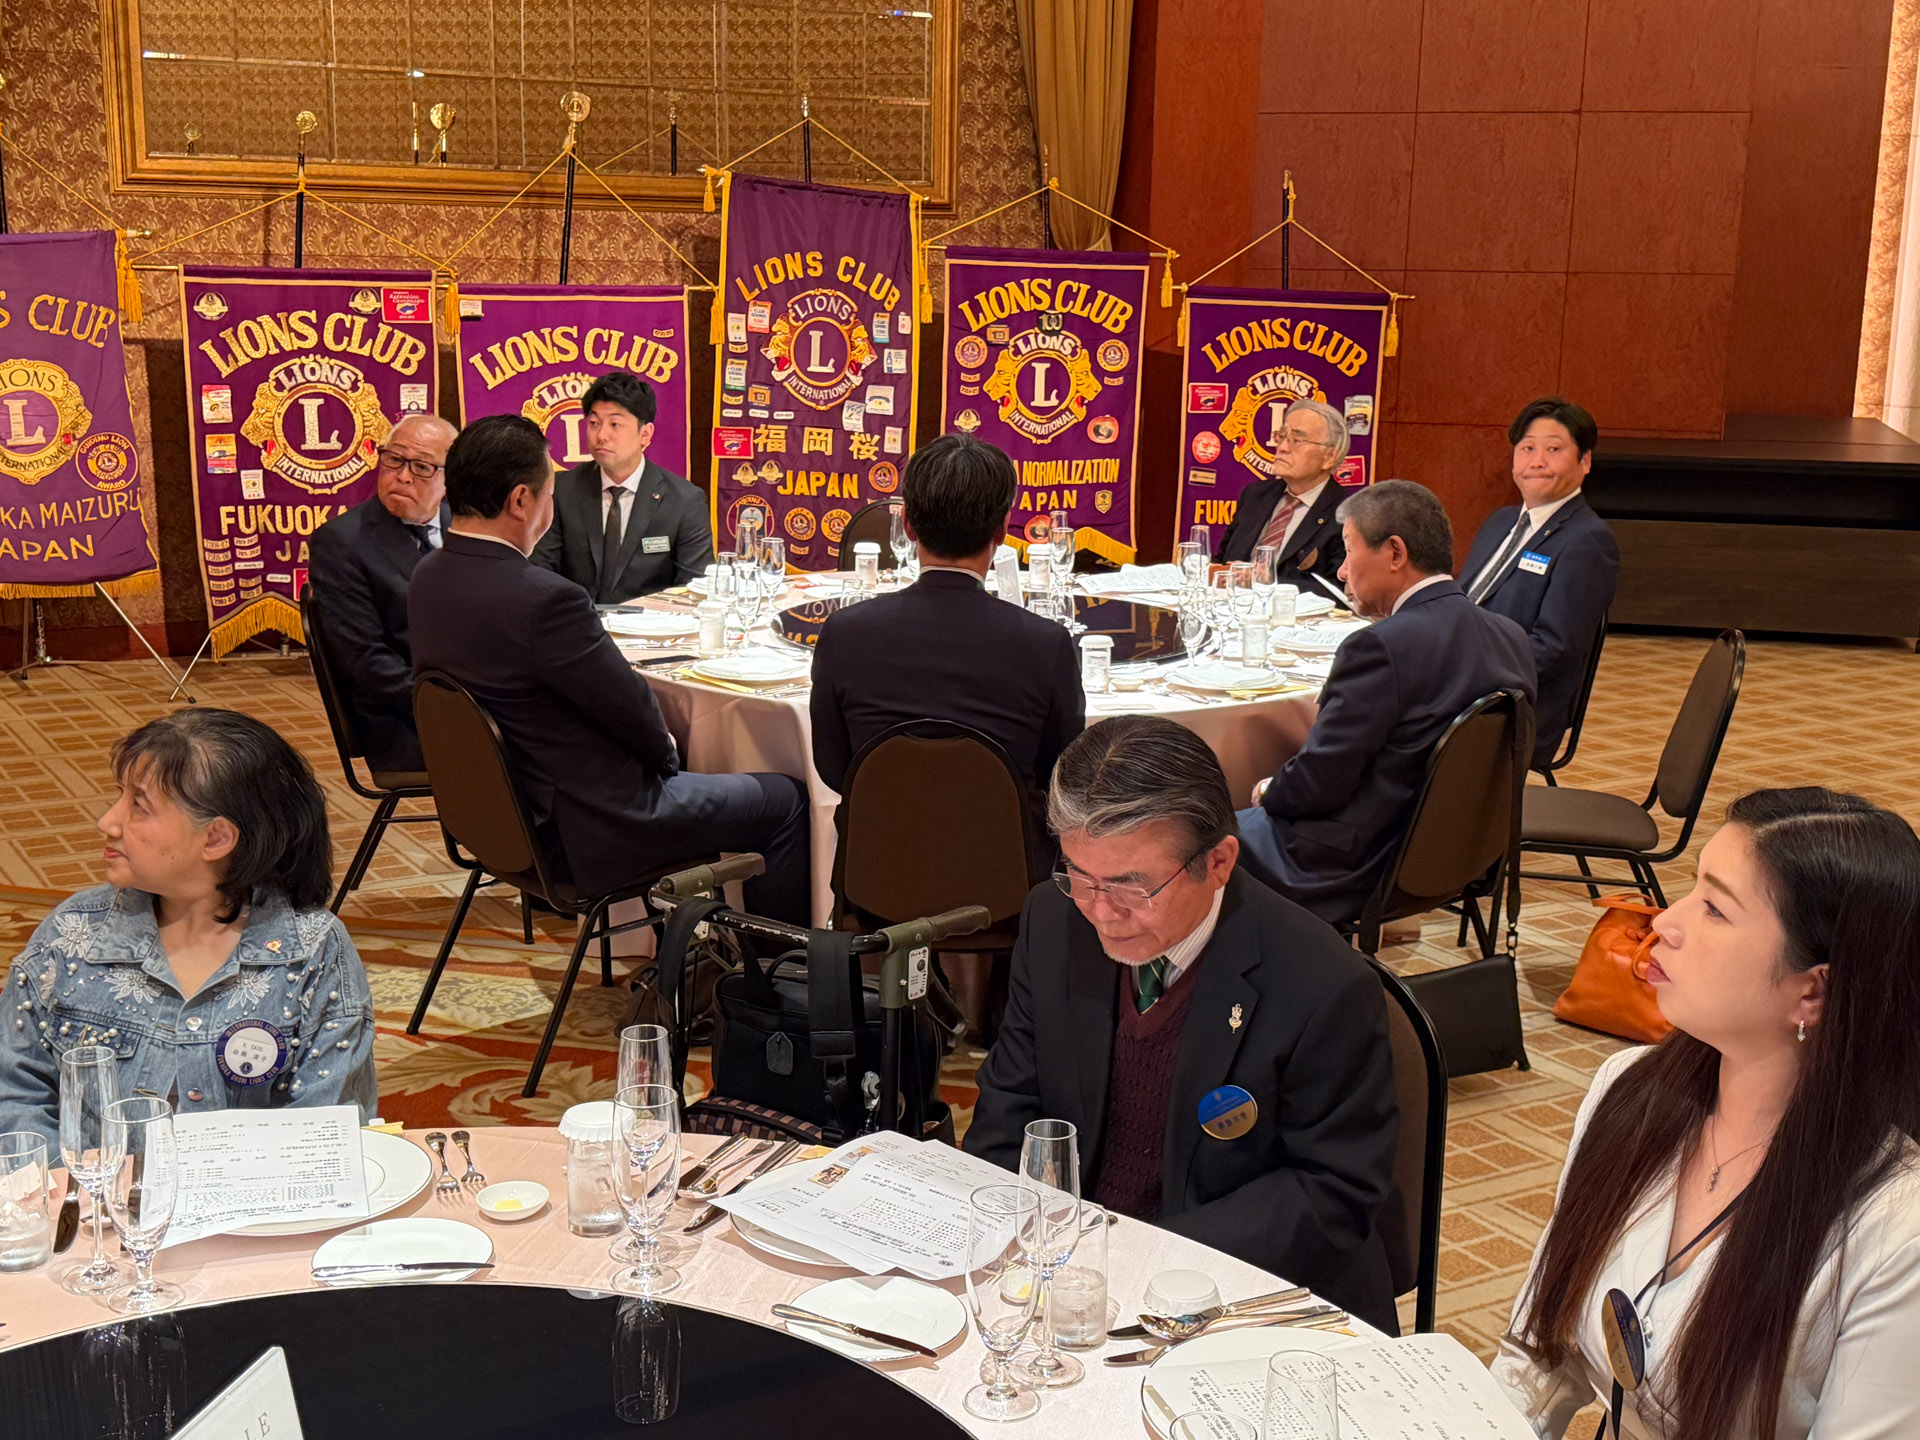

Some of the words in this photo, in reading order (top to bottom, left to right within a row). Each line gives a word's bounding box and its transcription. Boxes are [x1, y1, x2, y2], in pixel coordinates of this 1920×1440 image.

[735, 251, 823, 301] LIONS
[837, 256, 900, 311] CLUB
[28, 294, 116, 348] CLUB
[793, 295, 851, 320] LIONS
[958, 278, 1051, 332] LIONS
[1054, 280, 1134, 334] CLUB
[199, 310, 318, 378] LIONS
[323, 312, 426, 375] CLUB
[469, 326, 578, 390] LIONS
[584, 328, 679, 383] CLUB
[807, 331, 835, 373] L
[1016, 332, 1075, 356] LIONS
[1201, 318, 1291, 373] LIONS
[1293, 320, 1368, 377] CLUB
[277, 362, 357, 390] LIONS
[788, 375, 853, 400] INTERNATIONAL
[1030, 362, 1059, 407] L
[1253, 372, 1312, 397] LIONS
[3, 399, 46, 446] L
[298, 398, 343, 450] L
[560, 414, 595, 462] L
[1010, 410, 1075, 435] INTERNATIONAL
[111, 435, 129, 450] LION
[754, 424, 880, 461] 福岡桜
[97, 480, 126, 490] AWARD
[276, 455, 366, 484] INTERNATIONAL
[777, 470, 859, 499] JAPAN
[1023, 458, 1120, 486] NORMALIZATION
[39, 487, 140, 529] MAIZURU
[1013, 490, 1077, 511] APAN
